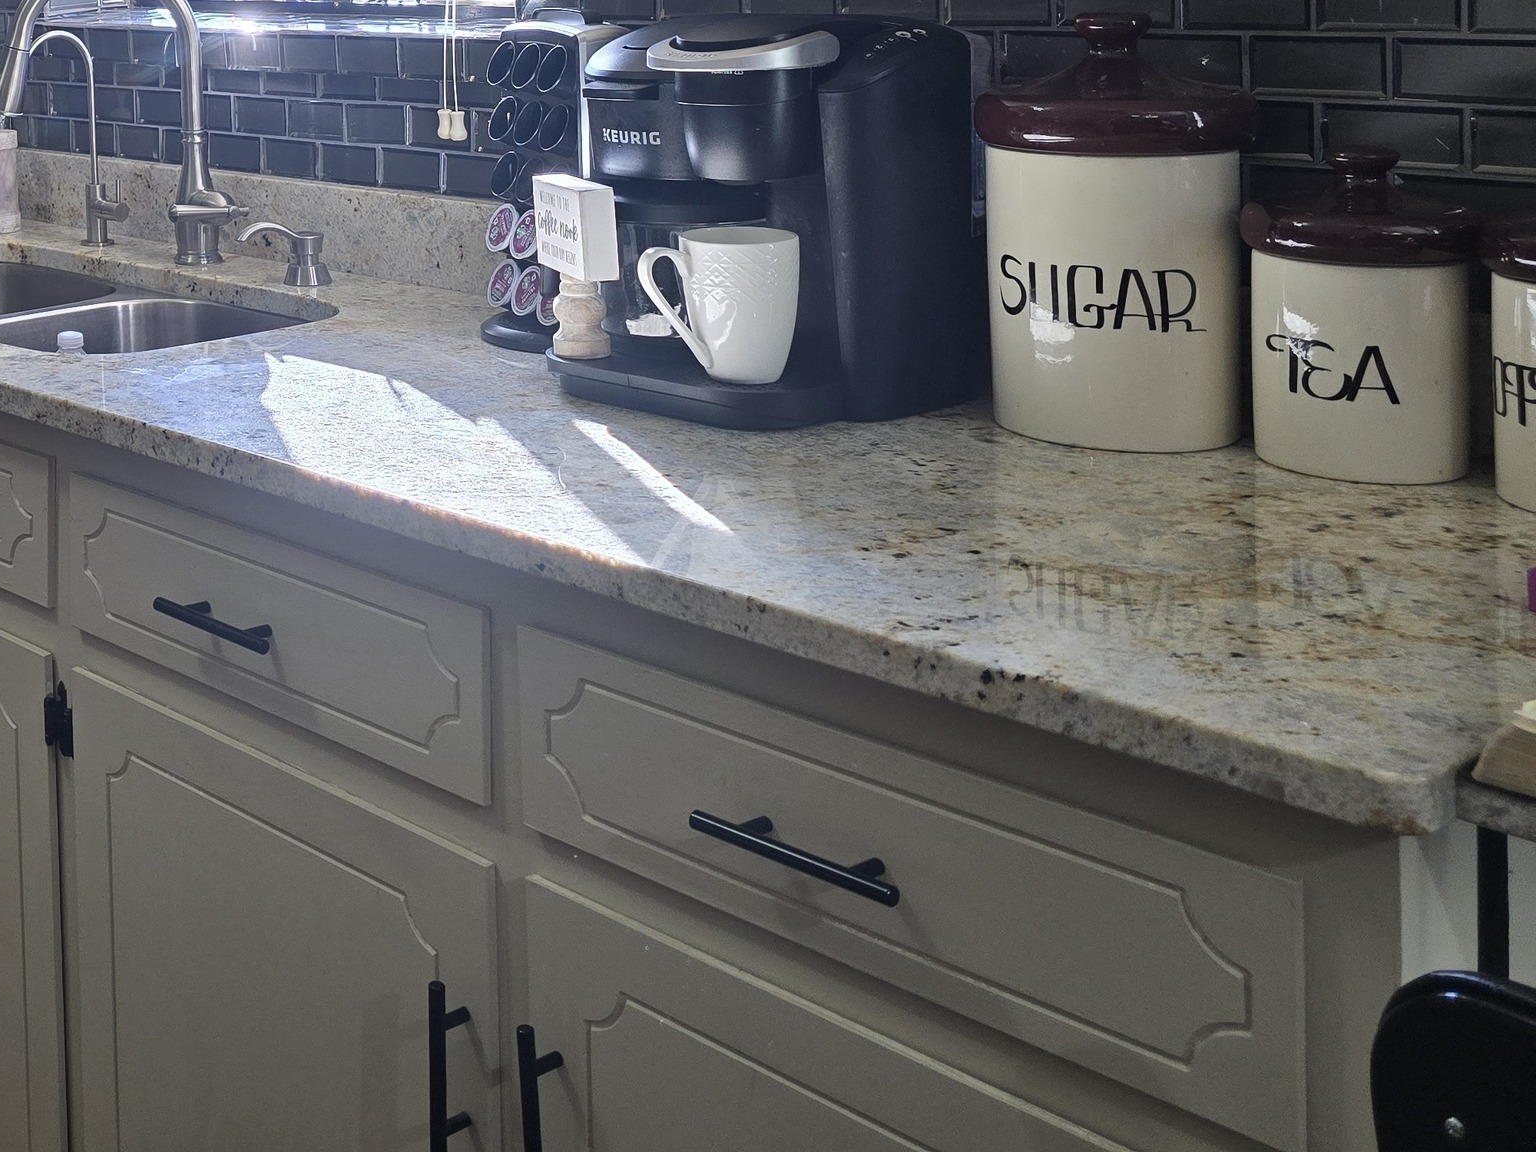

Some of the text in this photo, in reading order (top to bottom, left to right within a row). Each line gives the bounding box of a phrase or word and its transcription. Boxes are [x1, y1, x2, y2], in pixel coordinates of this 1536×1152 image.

[602, 128, 661, 145] KEURIG
[559, 218, 579, 243] nook
[999, 254, 1208, 332] SUGAR
[1265, 334, 1402, 406] TEA
